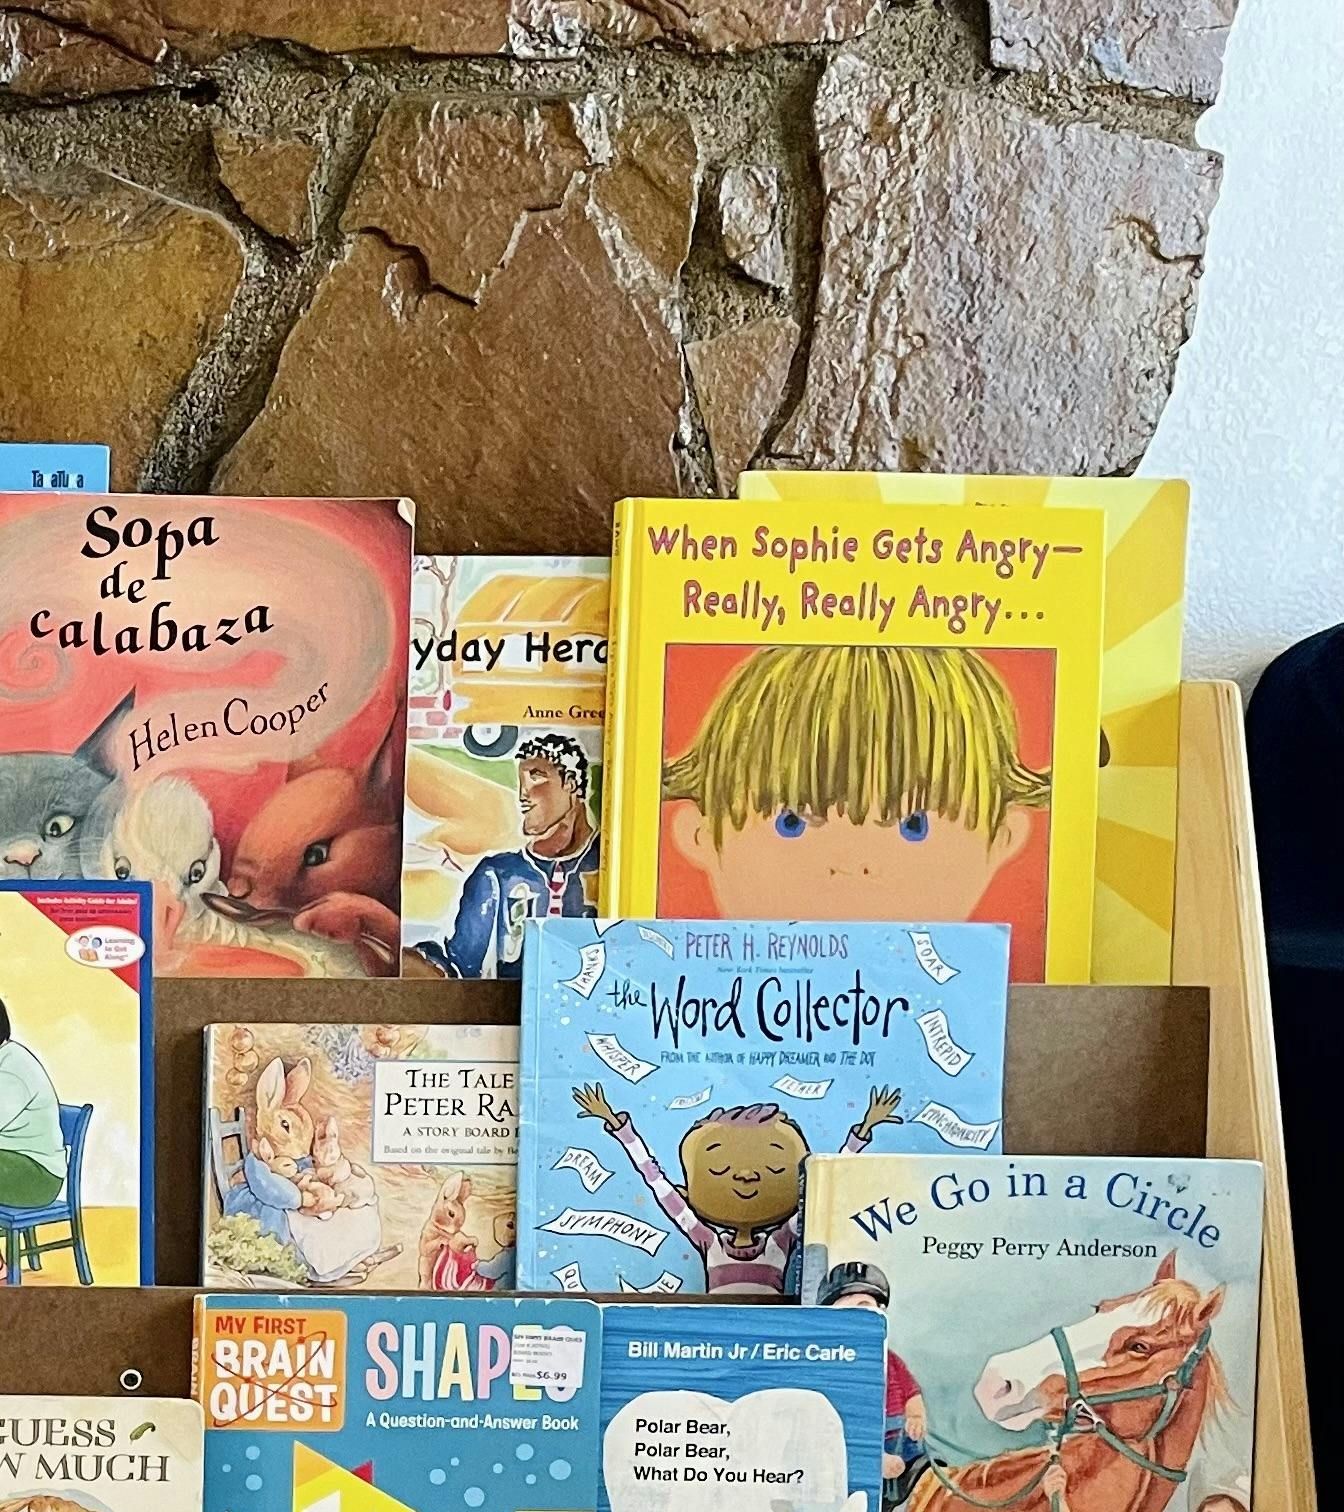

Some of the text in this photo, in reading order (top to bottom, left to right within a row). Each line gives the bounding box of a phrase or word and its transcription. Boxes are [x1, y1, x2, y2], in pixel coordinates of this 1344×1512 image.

[81, 504, 220, 581] Sopa
[646, 526, 738, 560] When
[751, 524, 859, 573] Sophie
[871, 531, 943, 565] Gets
[99, 560, 147, 604] de
[682, 580, 1047, 633] Really, Really Angry...
[30, 601, 275, 655] calabaza
[127, 682, 330, 771] Helen Cooper
[917, 939, 944, 977] SOAR
[606, 970, 910, 1049] the Word Collector
[596, 1037, 640, 1076] WHISPER
[924, 1015, 961, 1066] INTREPID
[563, 1152, 603, 1185] DREAM
[850, 1163, 1221, 1249] We Go in a Circle
[560, 1215, 658, 1244] SYMPHONY
[215, 1316, 307, 1335] MY FIRST
[537, 1371, 567, 1380] $6.99
[210, 1383, 337, 1423] QUEST
[366, 1413, 579, 1431] A Question-and-Answer Book
[635, 1419, 731, 1437] Polar Bear,
[36, 1454, 170, 1483] MUCH
[634, 1443, 729, 1461] Polar Bear,
[633, 1466, 804, 1484] What Do You Hear?
